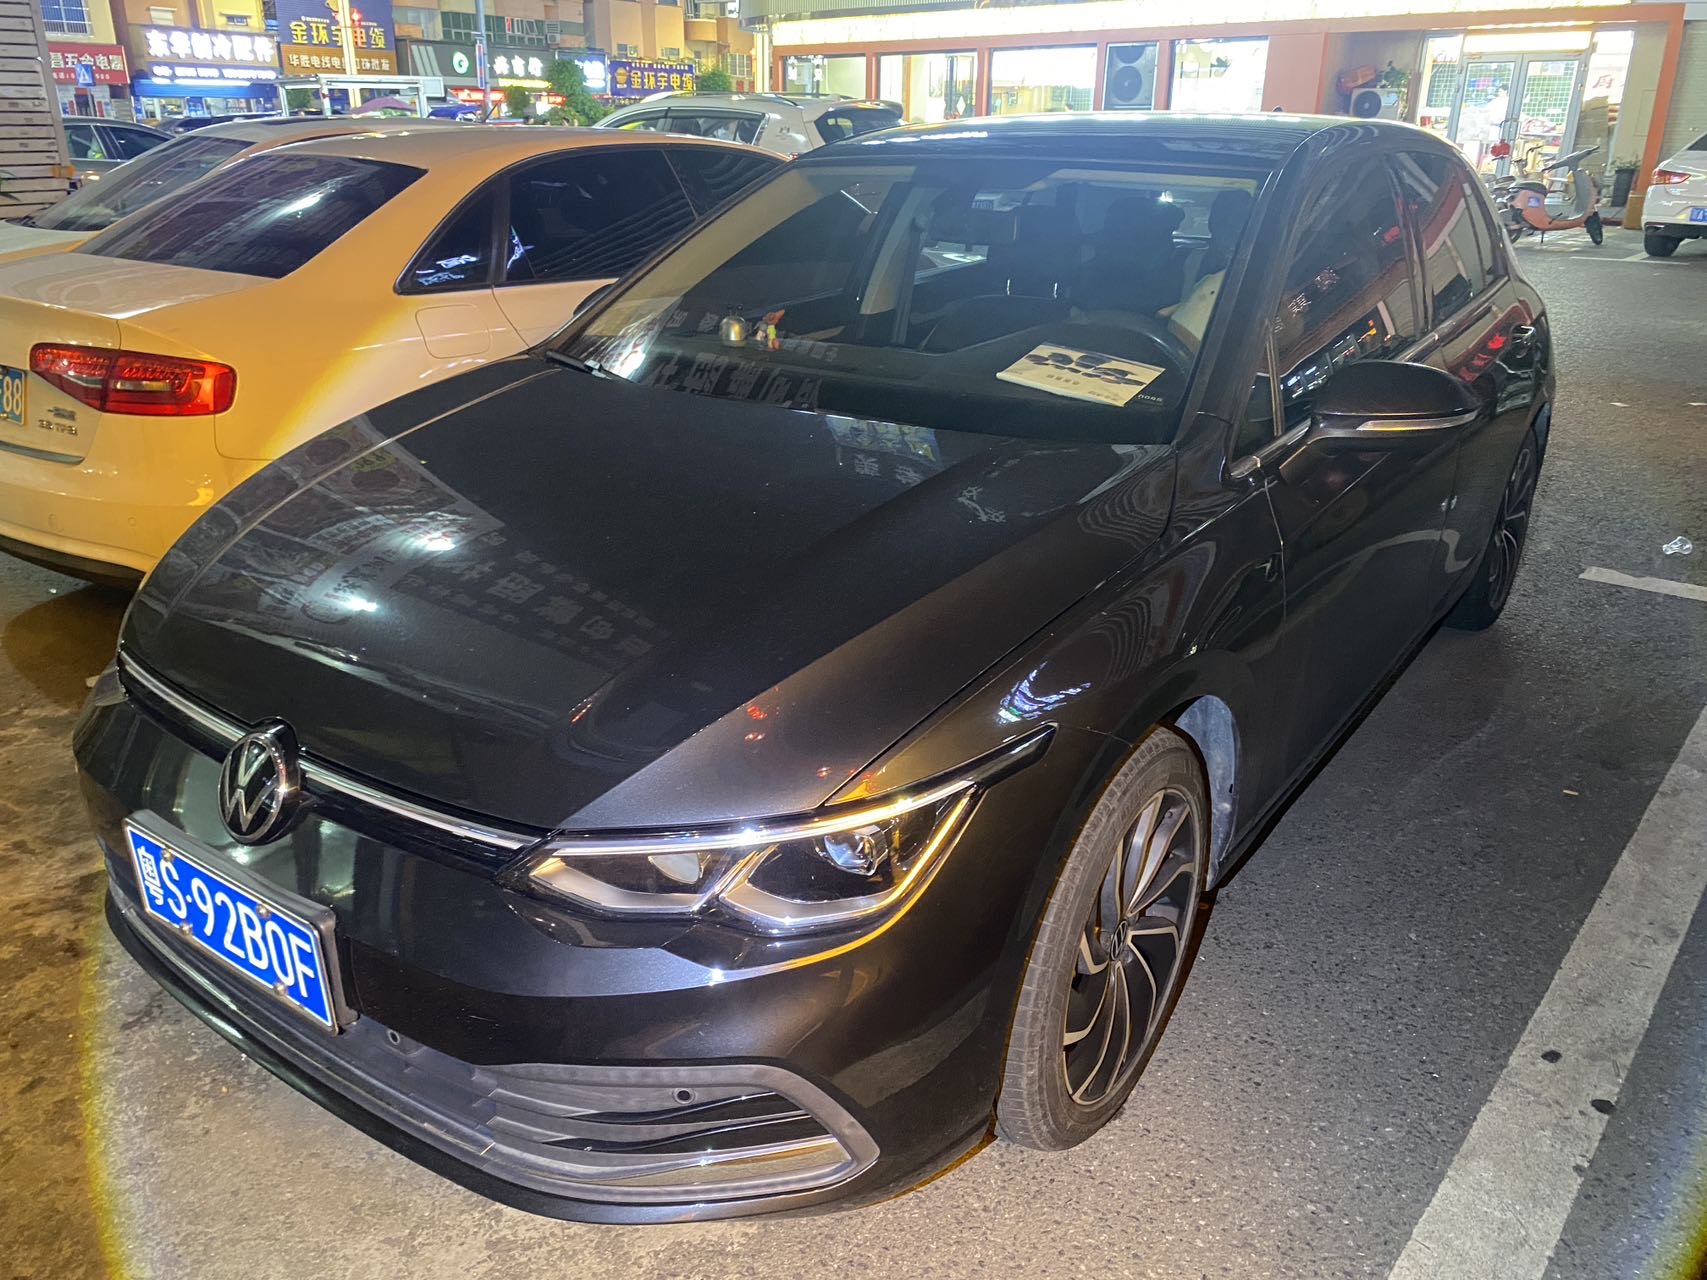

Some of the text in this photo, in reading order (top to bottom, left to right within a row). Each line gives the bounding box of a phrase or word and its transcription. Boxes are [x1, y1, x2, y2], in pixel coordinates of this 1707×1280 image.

[631, 70, 693, 91] 金环宇电缆
[0, 374, 22, 416] 88
